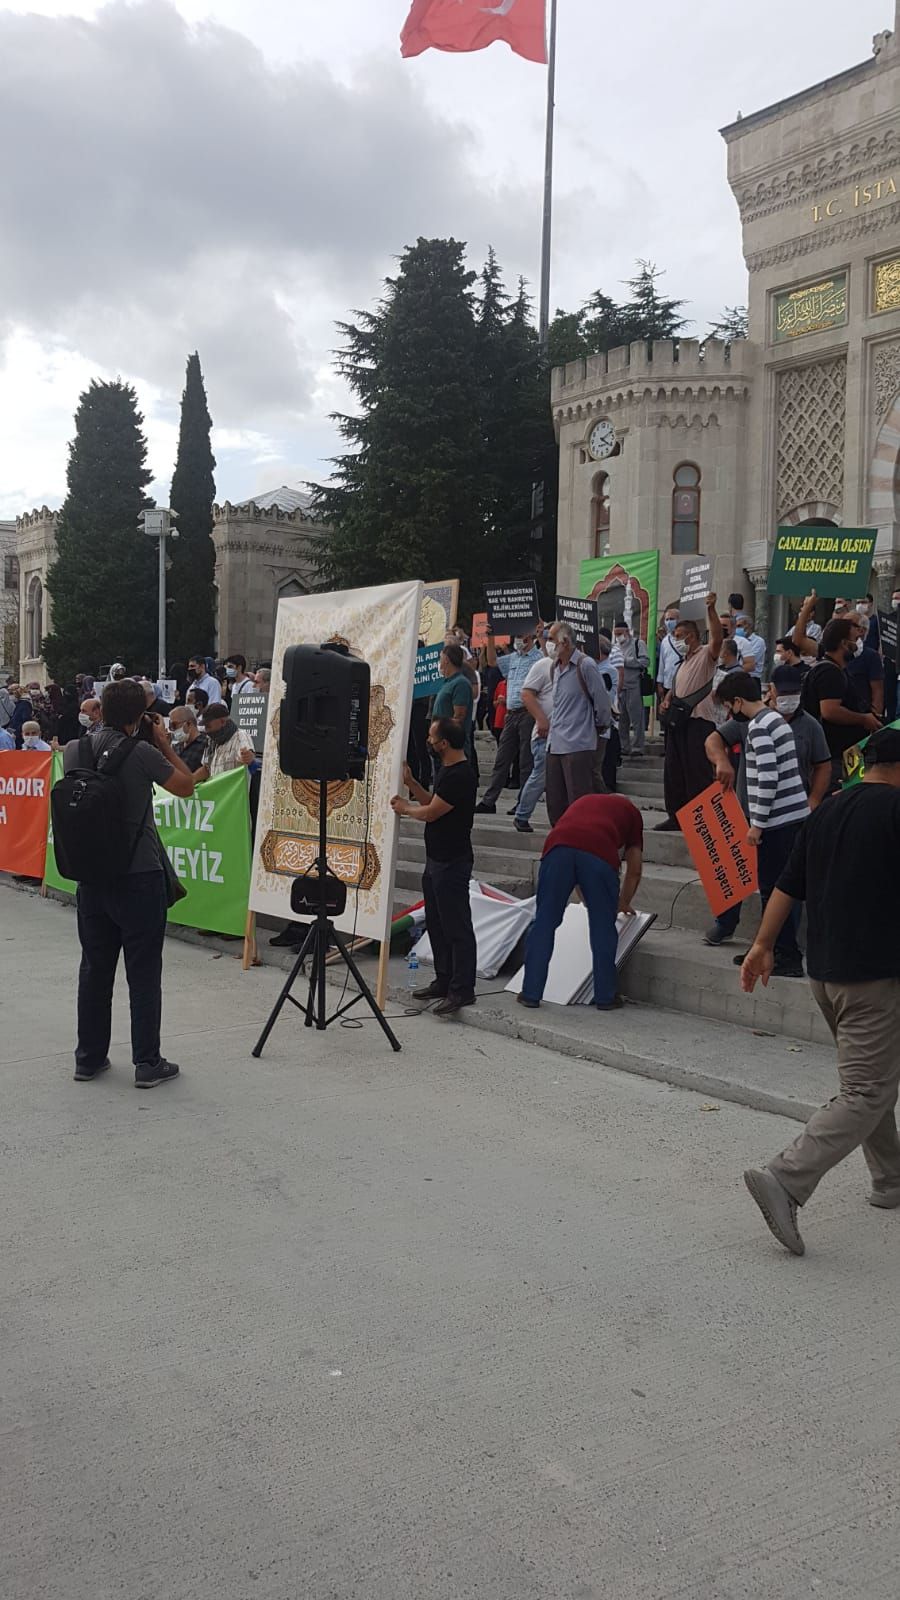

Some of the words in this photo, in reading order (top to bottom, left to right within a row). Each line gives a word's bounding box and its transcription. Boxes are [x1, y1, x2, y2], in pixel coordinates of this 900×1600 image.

[854, 176, 897, 208] İSTA
[778, 536, 814, 551] CANLAR
[815, 538, 839, 552] FEDA
[841, 539, 873, 553] OLSUN
[784, 557, 797, 571] YA
[797, 558, 858, 574] RESULALLAH
[558, 598, 593, 611] KAHROLSUN
[563, 610, 588, 621] AMERİKA
[238, 706, 262, 716] UZANAN
[240, 718, 258, 726] ELLER
[692, 804, 720, 865] Peygambere
[714, 865, 734, 900] siperiz
[729, 840, 752, 887] kardeşiz
